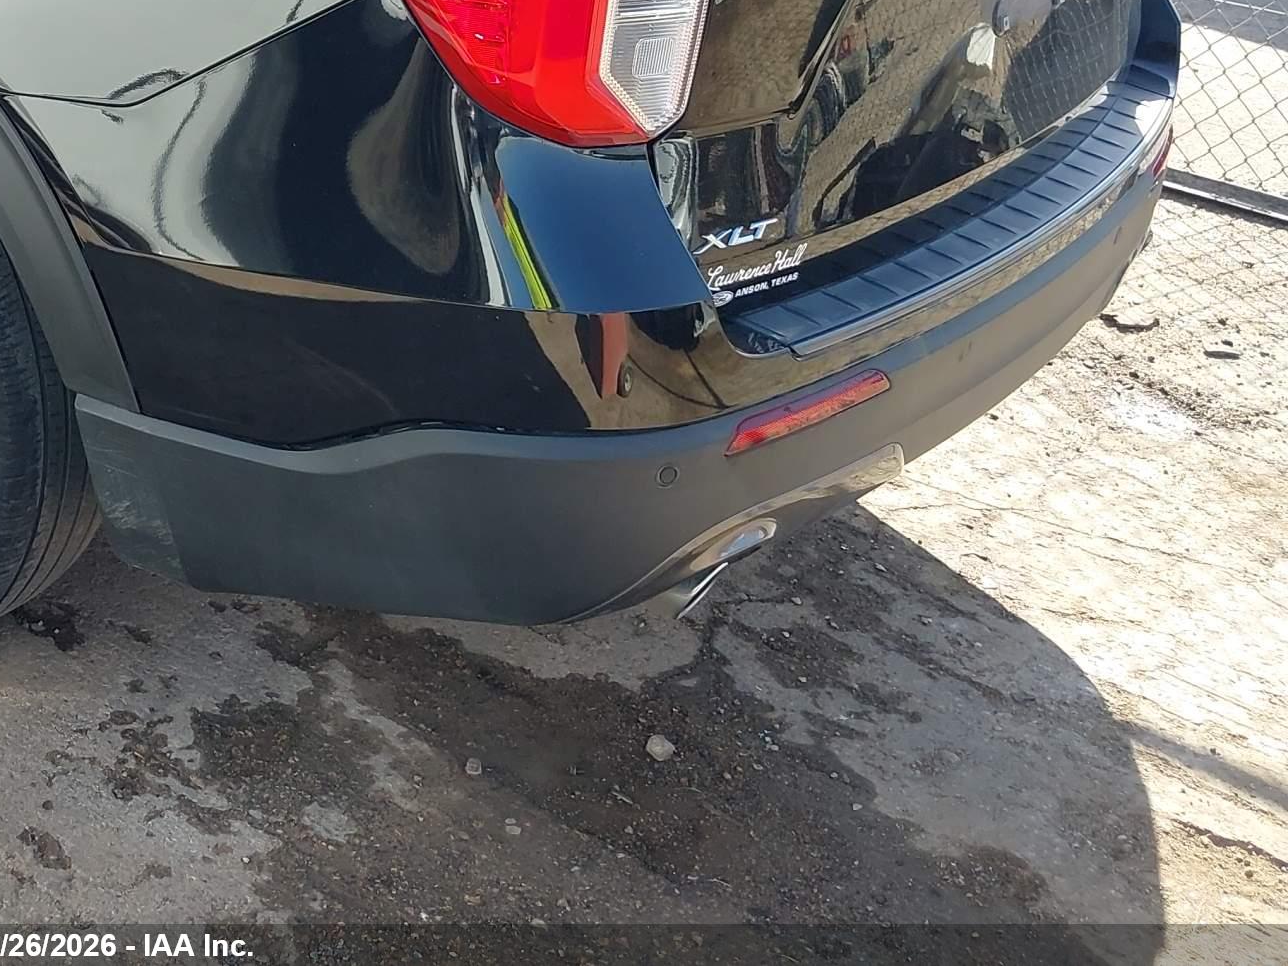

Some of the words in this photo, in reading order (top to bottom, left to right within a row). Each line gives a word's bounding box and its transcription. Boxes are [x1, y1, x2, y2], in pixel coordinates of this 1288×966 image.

[693, 218, 778, 254] XLT
[707, 263, 770, 291] Lawrence
[771, 242, 808, 273] Hall
[735, 282, 770, 298] ANSON,
[771, 272, 800, 287] TEXAS
